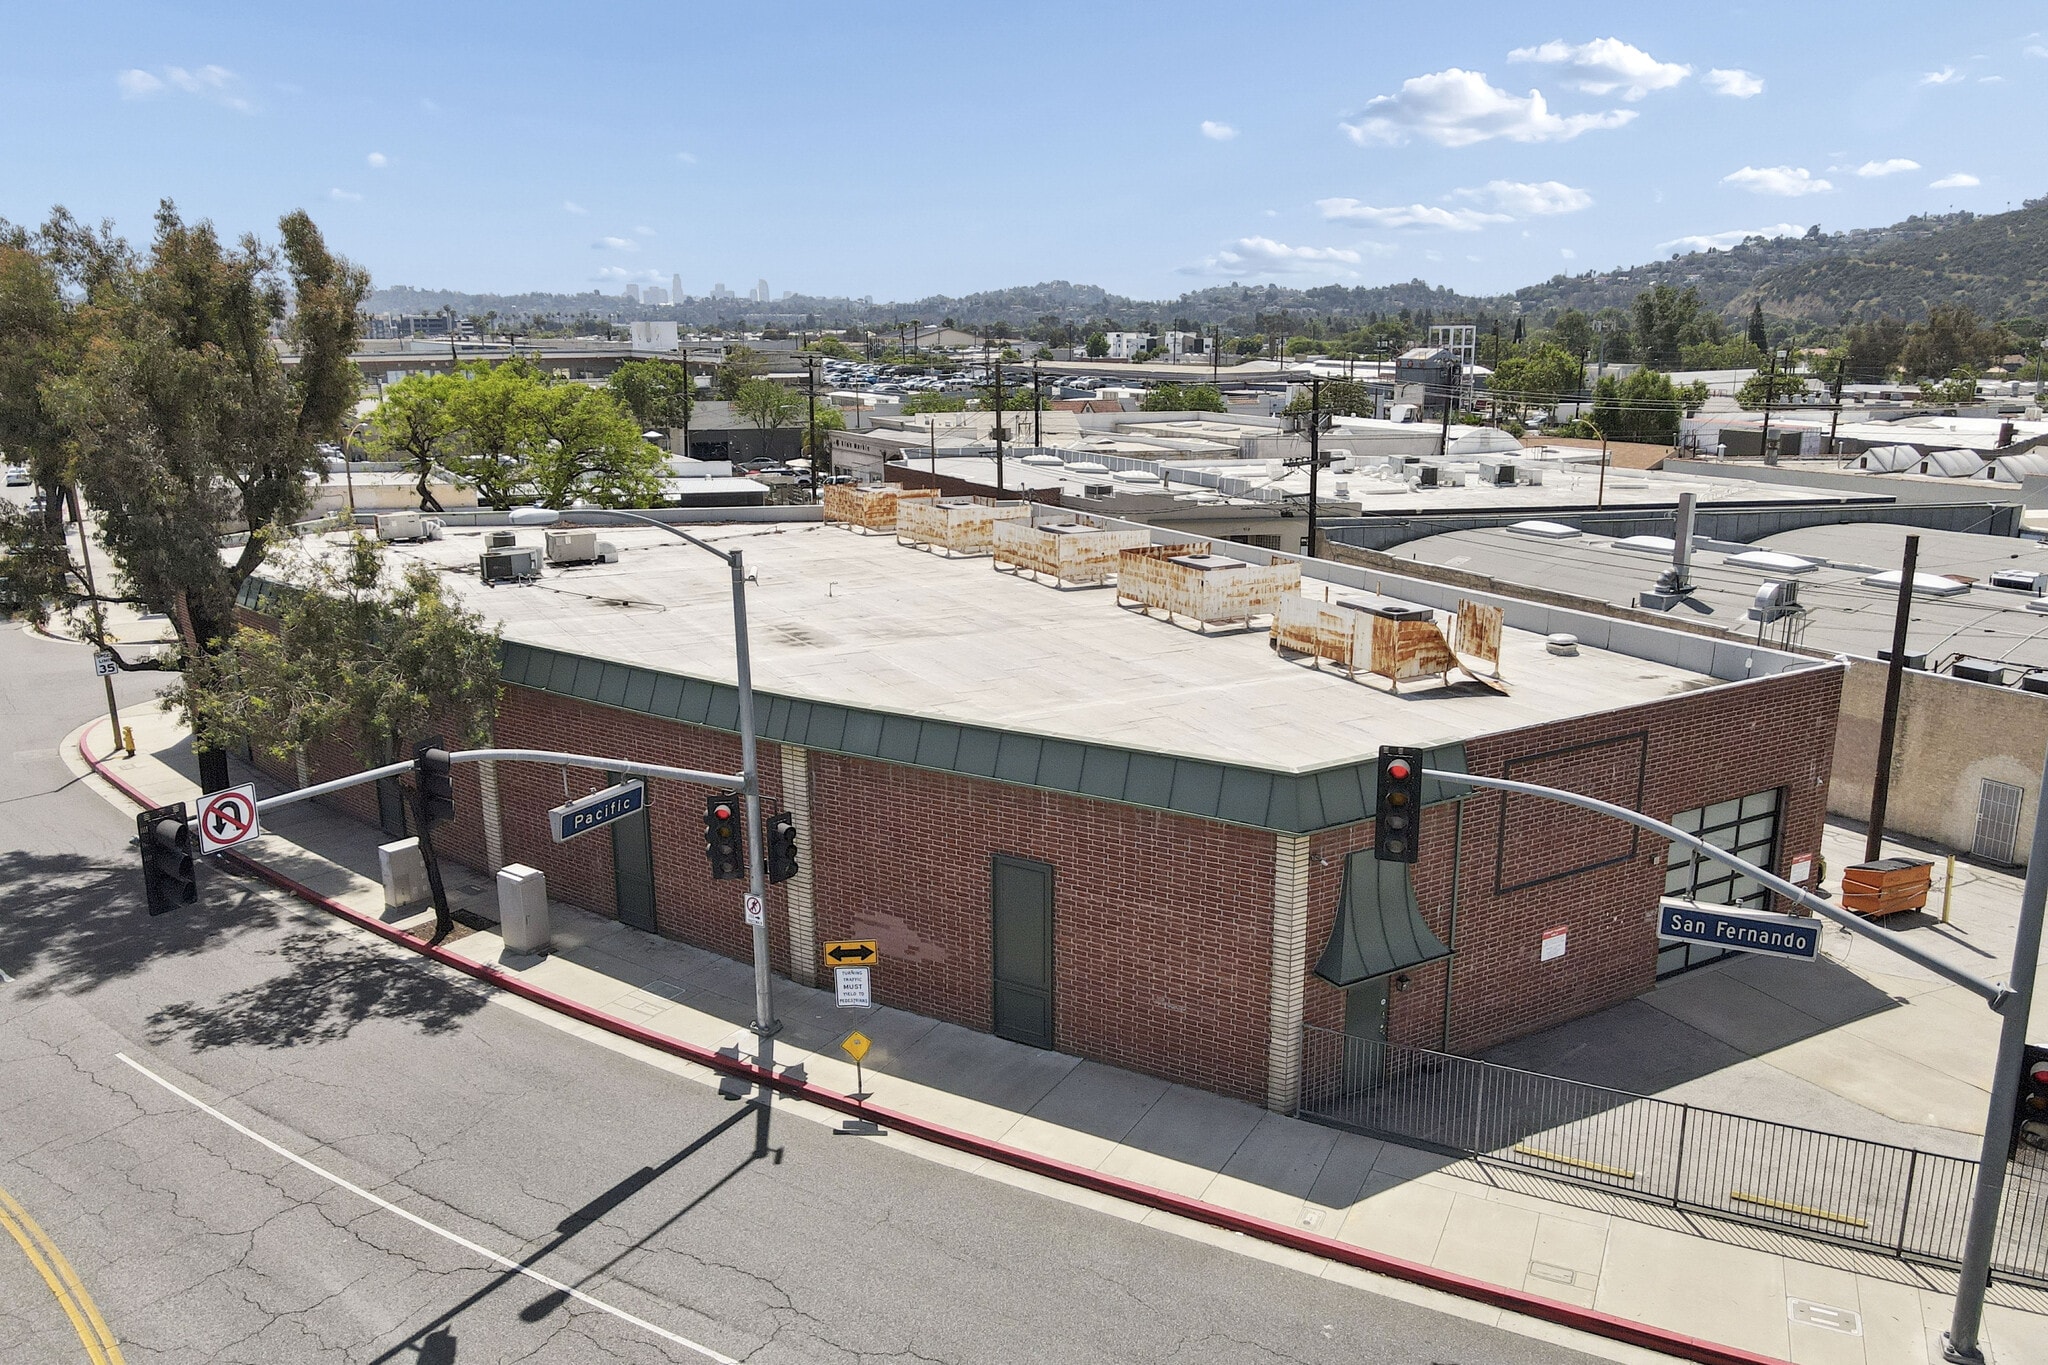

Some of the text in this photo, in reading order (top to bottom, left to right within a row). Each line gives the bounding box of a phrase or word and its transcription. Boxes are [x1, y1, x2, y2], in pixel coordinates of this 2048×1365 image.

[99, 663, 115, 673] 35
[574, 798, 630, 828] Pacific
[1671, 914, 1806, 950] San Fernando
